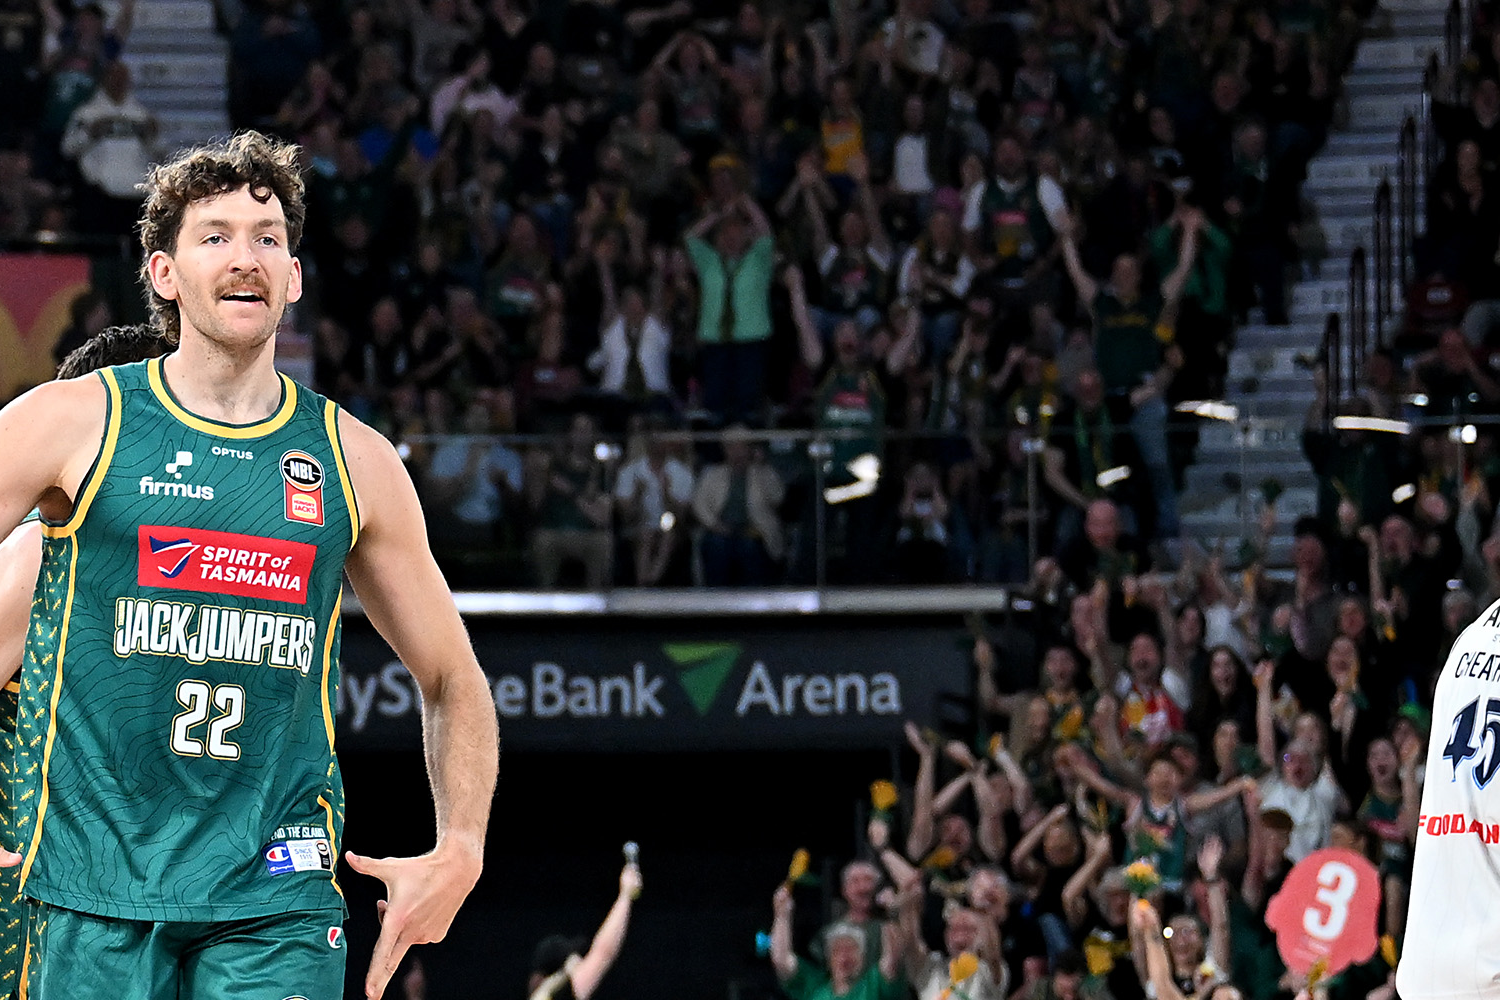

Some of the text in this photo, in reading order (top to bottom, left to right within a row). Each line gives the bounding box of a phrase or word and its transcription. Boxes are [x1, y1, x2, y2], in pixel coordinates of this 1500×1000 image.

[211, 446, 254, 460] OPTUS
[289, 460, 316, 481] NBL
[139, 476, 215, 501] firmus
[201, 545, 293, 571] SPIRIT of
[200, 564, 301, 592] TASMANIA
[735, 660, 902, 717] Arena
[170, 679, 246, 761] 22
[1443, 695, 1500, 790] 45
[286, 826, 301, 838] THE
[301, 826, 327, 838] ISLAND
[1302, 861, 1358, 940] 3
